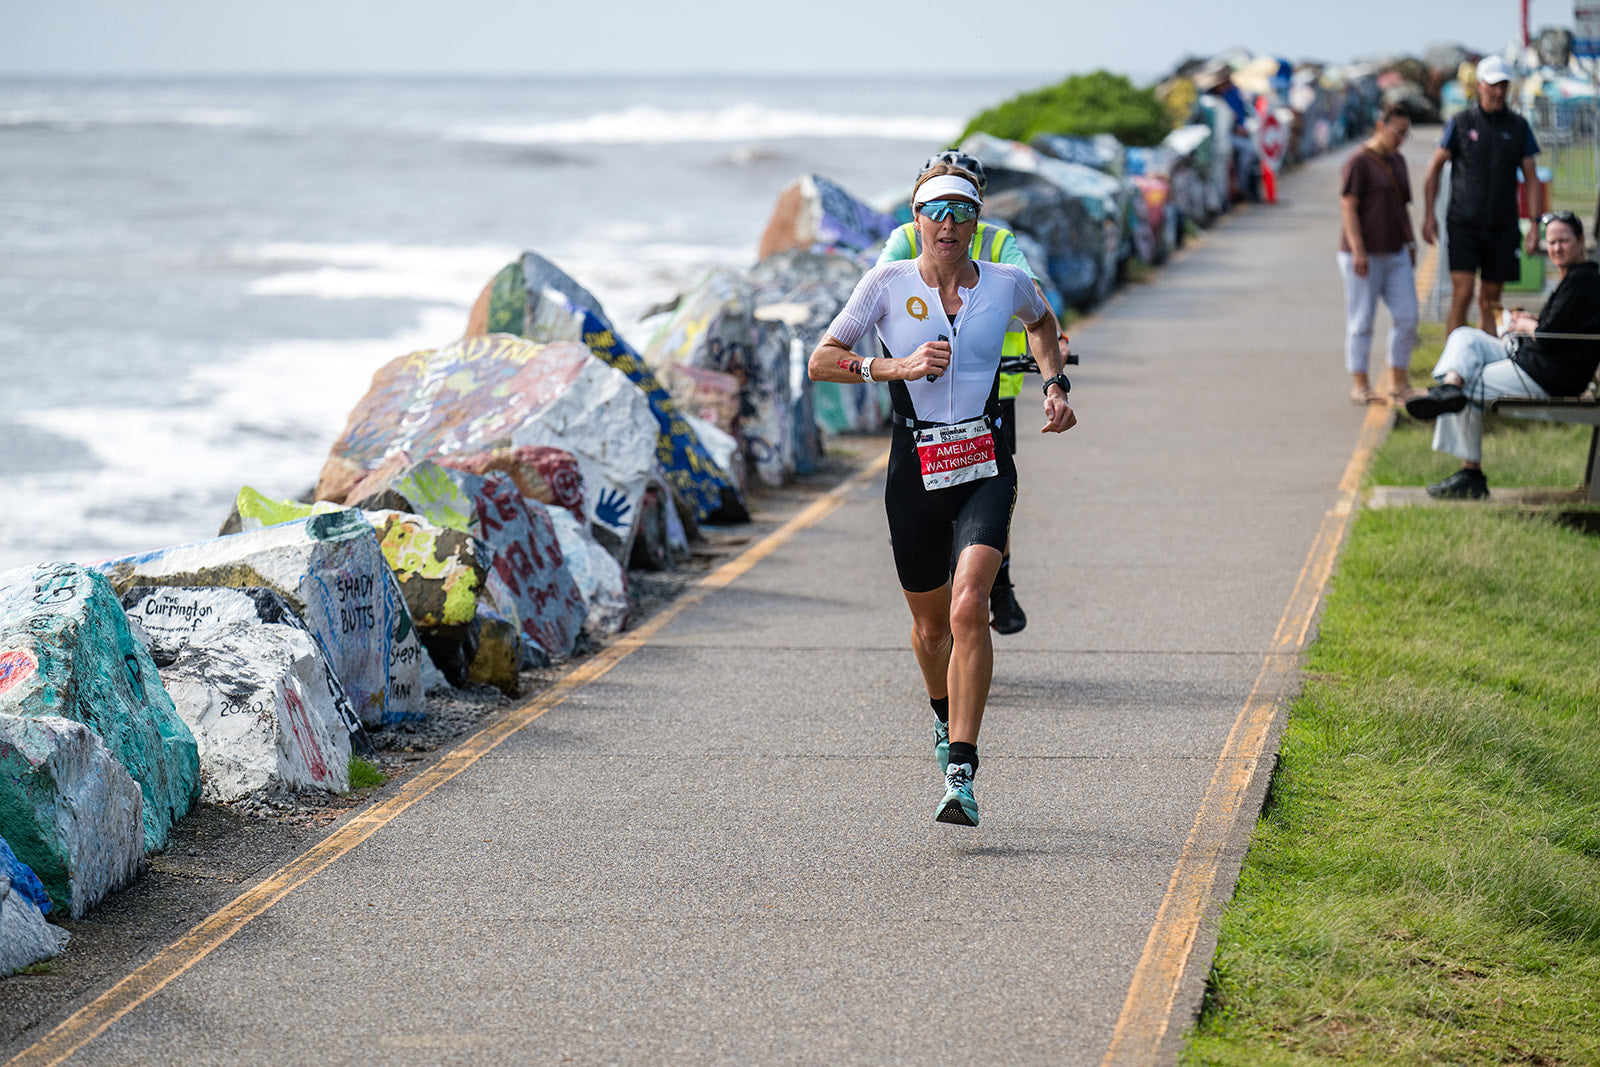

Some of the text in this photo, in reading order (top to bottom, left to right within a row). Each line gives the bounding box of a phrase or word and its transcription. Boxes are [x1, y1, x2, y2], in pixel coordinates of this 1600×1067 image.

[974, 425, 985, 433] NZL
[936, 441, 977, 457] AMELIA
[926, 450, 988, 472] WATKINSON
[337, 572, 375, 602] SHADY
[145, 599, 213, 621] Currington
[163, 596, 179, 605] THE
[340, 605, 375, 634] BUTTS
[220, 701, 263, 718] 2020
